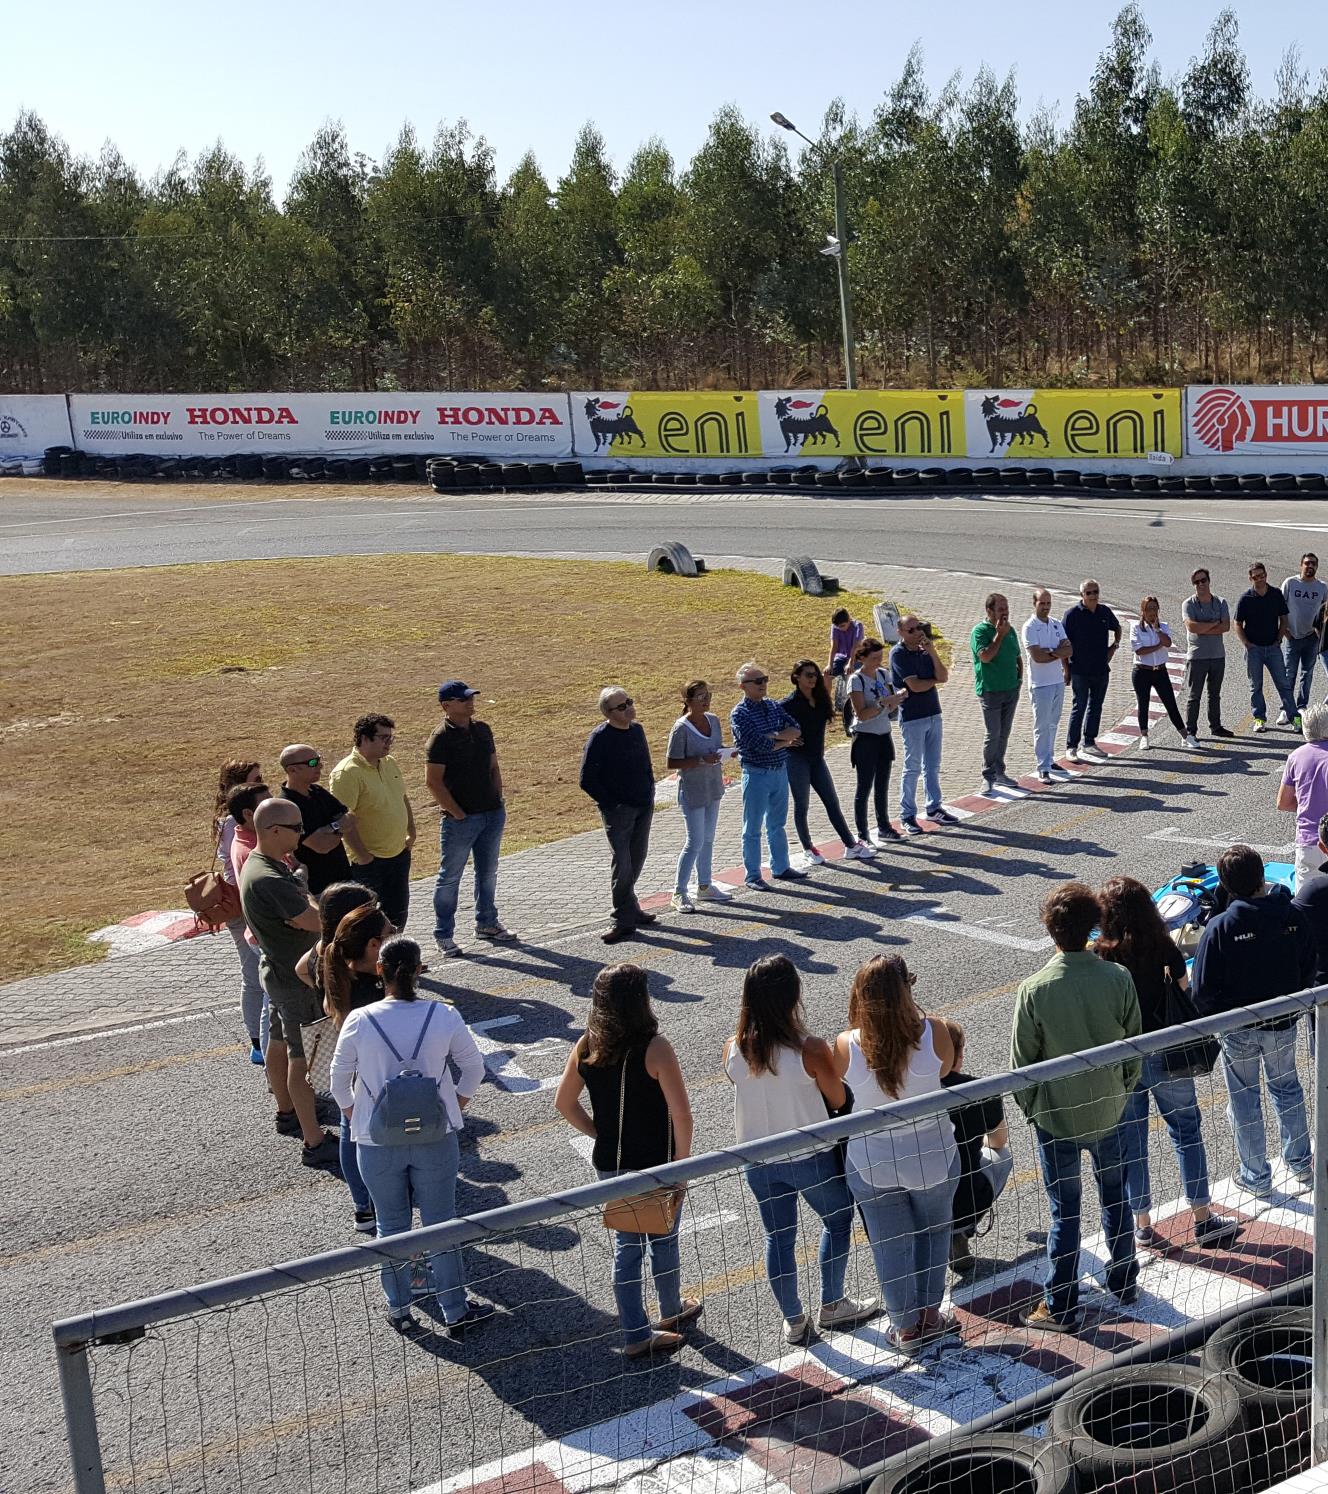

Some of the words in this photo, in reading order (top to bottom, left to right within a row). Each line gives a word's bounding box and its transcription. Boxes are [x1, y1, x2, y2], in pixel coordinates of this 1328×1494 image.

[90, 411, 171, 425] EUROINDY
[186, 407, 299, 425] HONDA
[330, 410, 421, 425] EUROINDY
[436, 407, 563, 425] HONDA
[657, 395, 750, 454] eni
[853, 394, 952, 454] eni
[1063, 393, 1168, 454] eni
[144, 433, 155, 441] em
[199, 431, 214, 440] The
[217, 431, 243, 441] Power
[246, 430, 255, 440] of
[257, 430, 291, 440] Dreams
[368, 431, 390, 441] Utiliza
[391, 433, 402, 441] em
[403, 431, 435, 441] exclusivo
[450, 432, 469, 441] The
[471, 432, 502, 442] Power
[504, 432, 514, 442] of
[516, 432, 556, 442] Dreams
[1294, 589, 1319, 599] GAP
